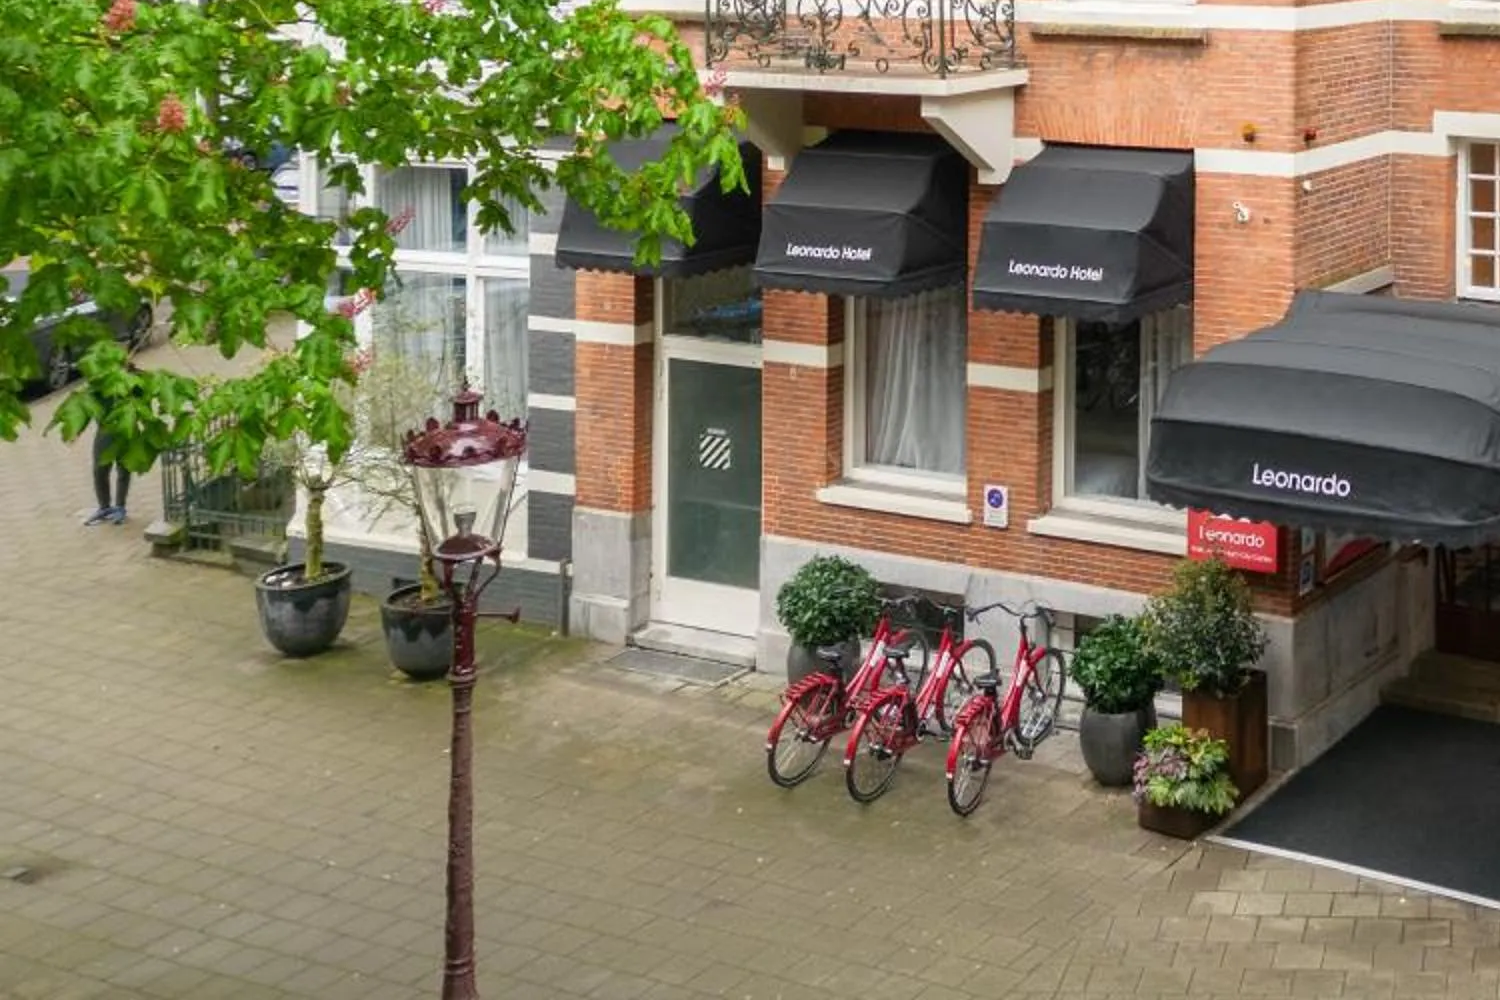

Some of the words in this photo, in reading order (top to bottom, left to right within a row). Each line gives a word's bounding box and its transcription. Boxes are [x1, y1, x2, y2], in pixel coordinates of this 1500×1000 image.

[786, 243, 840, 259] Leonardo
[842, 246, 872, 261] Hotel
[1008, 259, 1068, 279] Leonardo
[1069, 265, 1103, 282] Hotel
[1252, 463, 1351, 497] Leonardo
